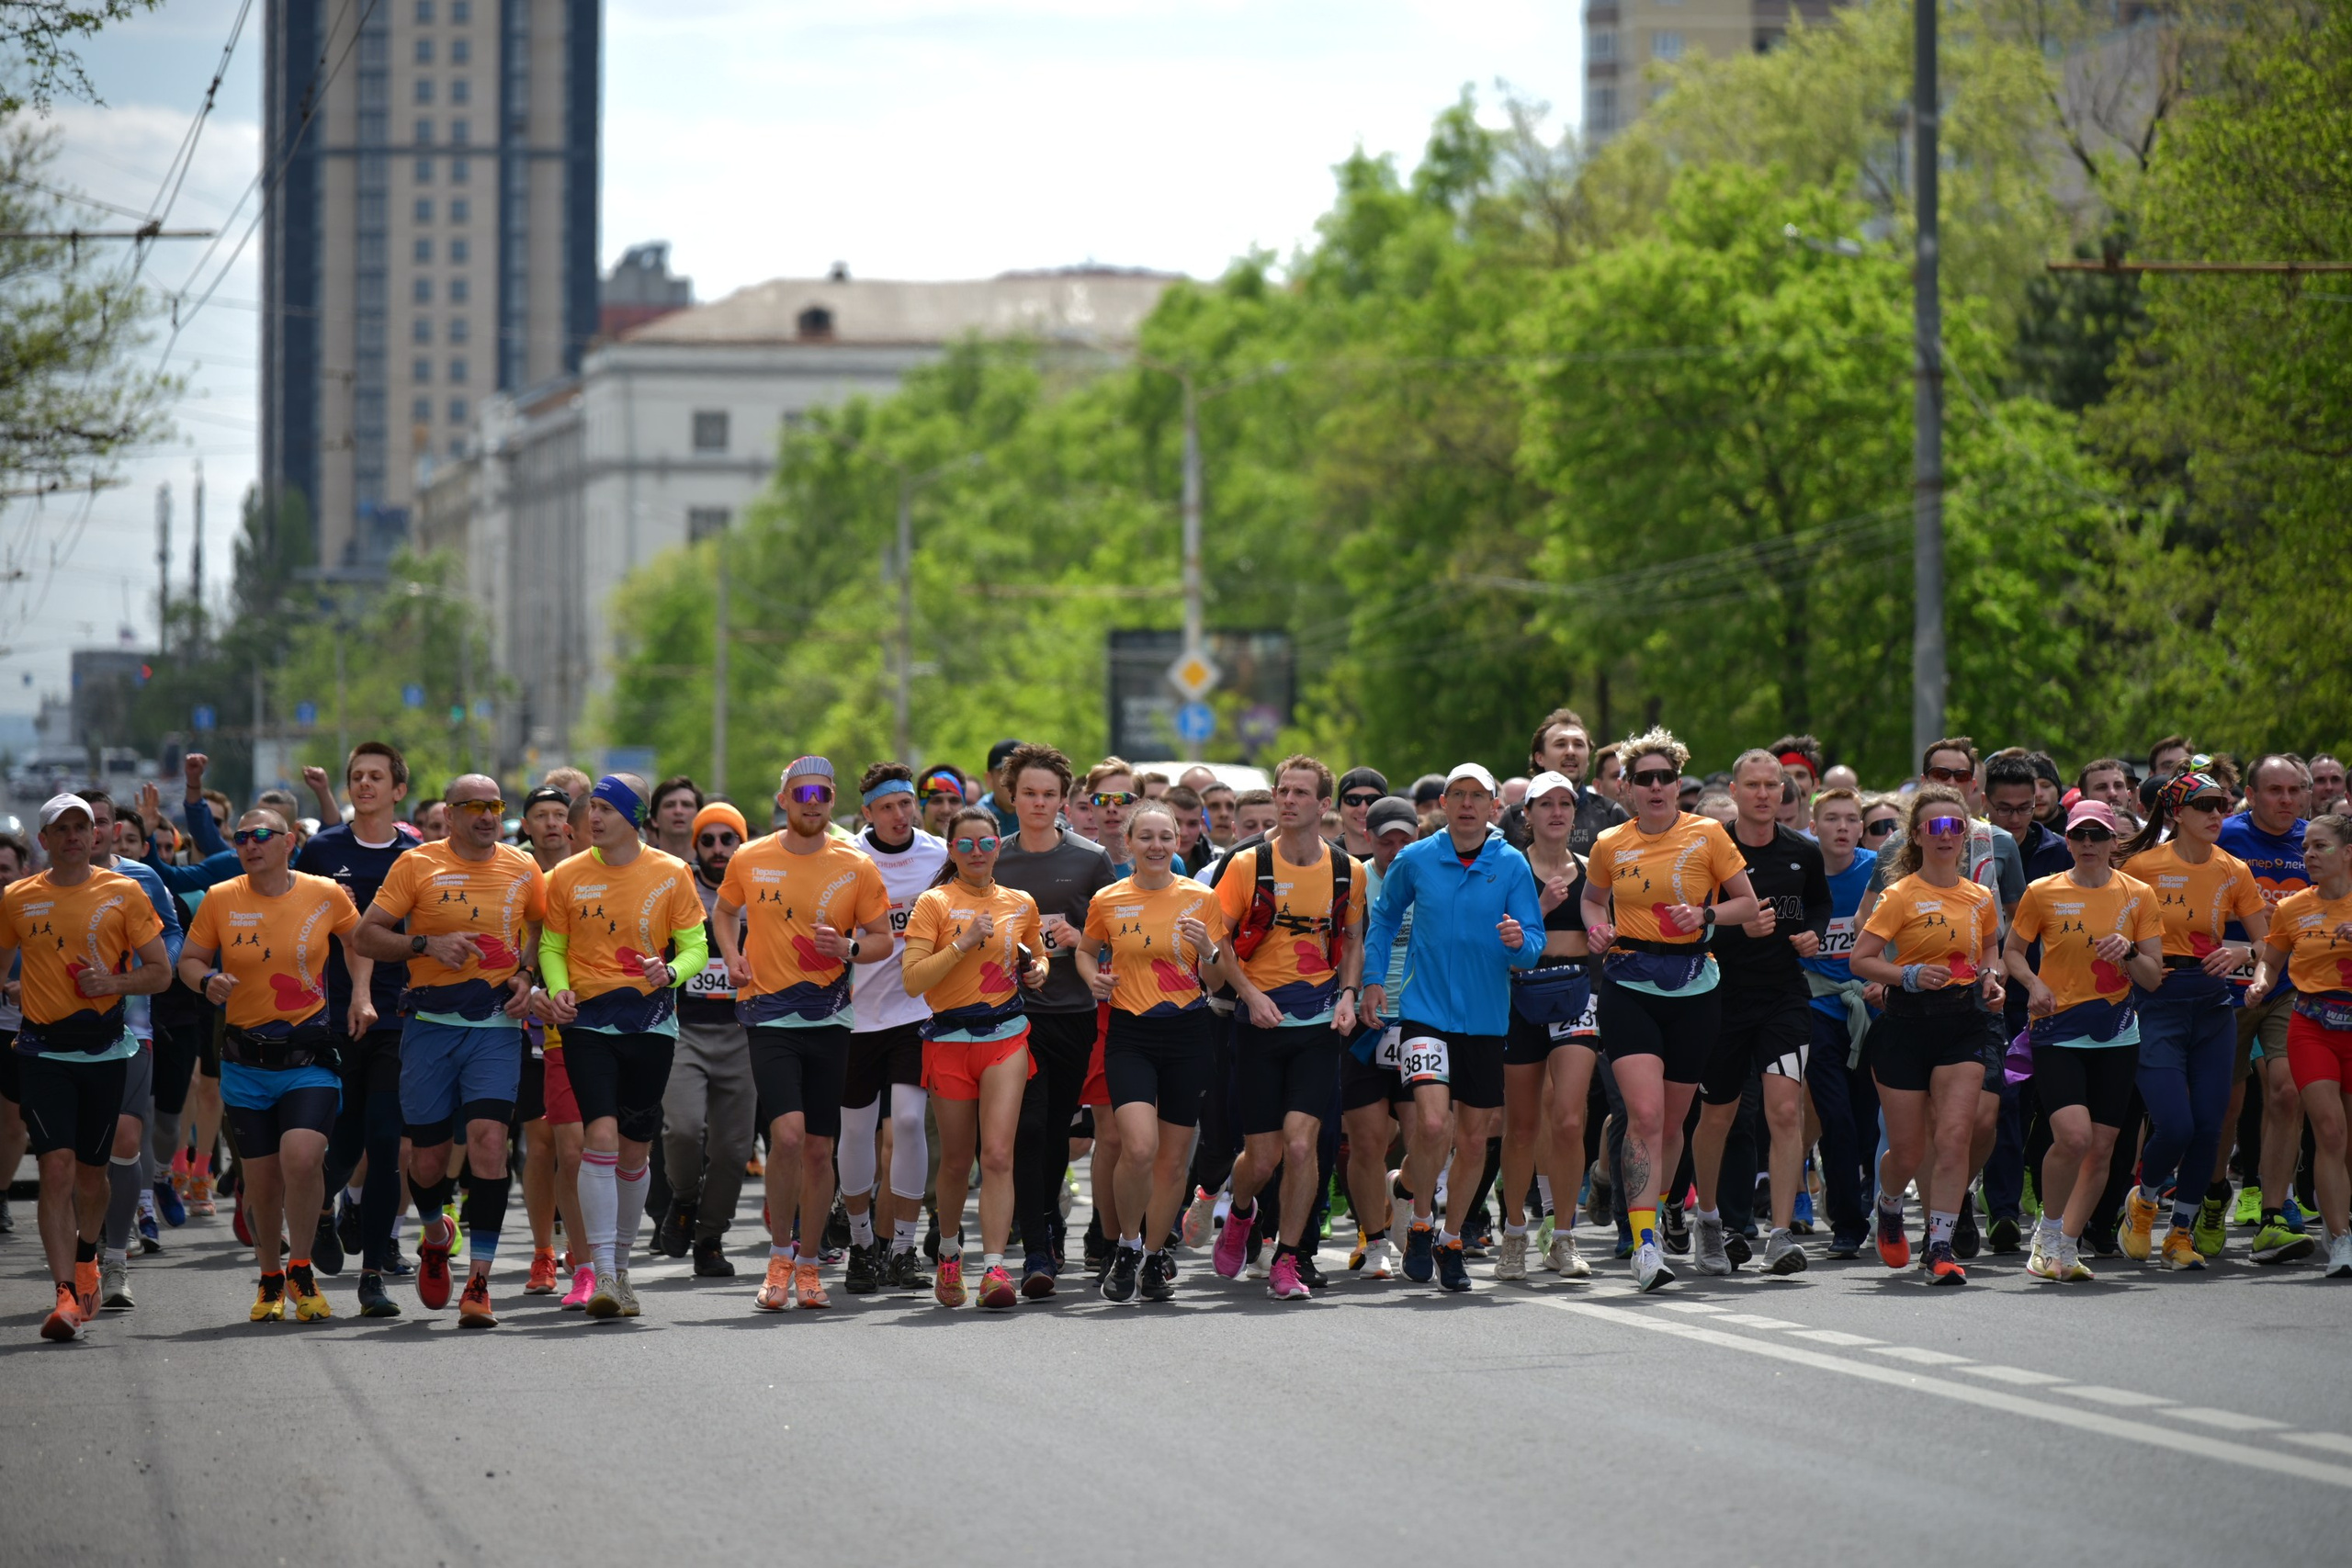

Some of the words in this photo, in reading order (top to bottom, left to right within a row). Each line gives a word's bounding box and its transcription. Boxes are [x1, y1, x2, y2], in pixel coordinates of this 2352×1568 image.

[299, 900, 332, 943] кольцо
[889, 909, 912, 931] 19
[1404, 1054, 1442, 1077] 3812
